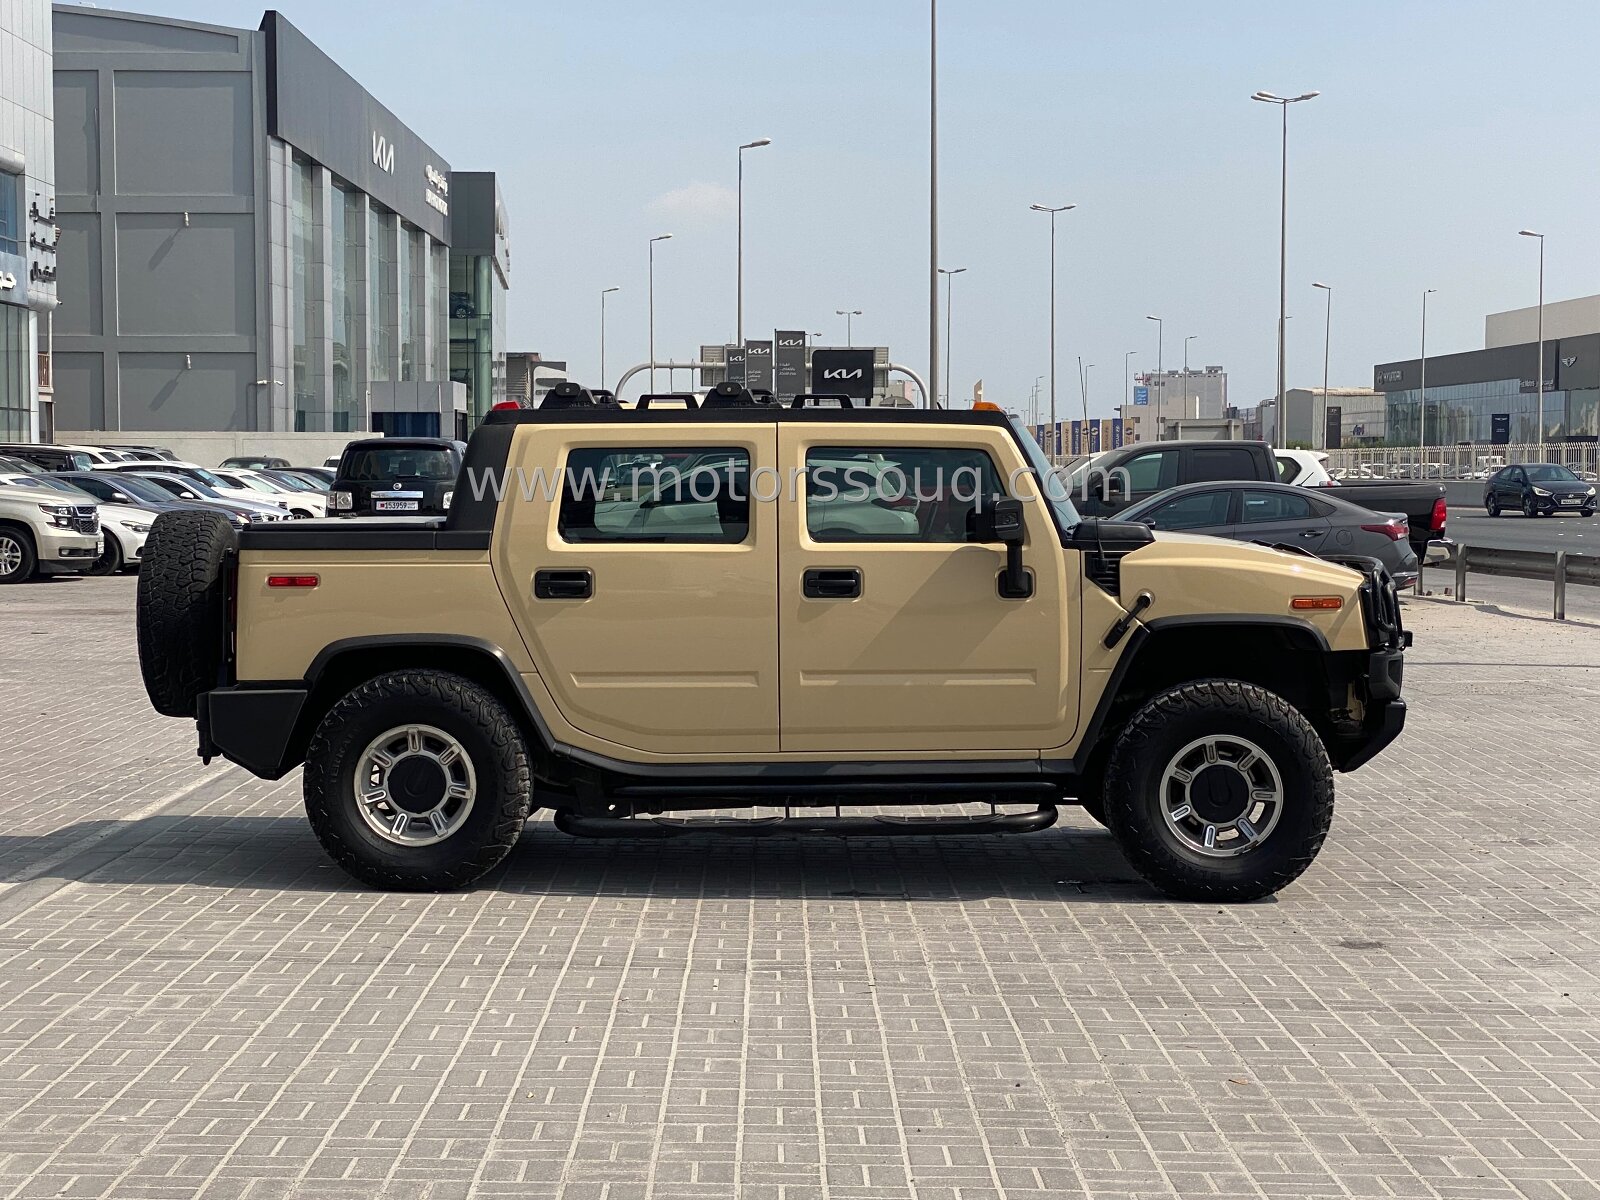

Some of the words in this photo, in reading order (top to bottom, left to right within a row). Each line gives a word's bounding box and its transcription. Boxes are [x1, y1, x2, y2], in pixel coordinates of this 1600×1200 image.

[372, 130, 395, 176] KIA
[779, 338, 803, 347] KIA
[748, 347, 770, 355] KIA
[823, 368, 863, 379] KIA
[384, 501, 408, 509] 153959
